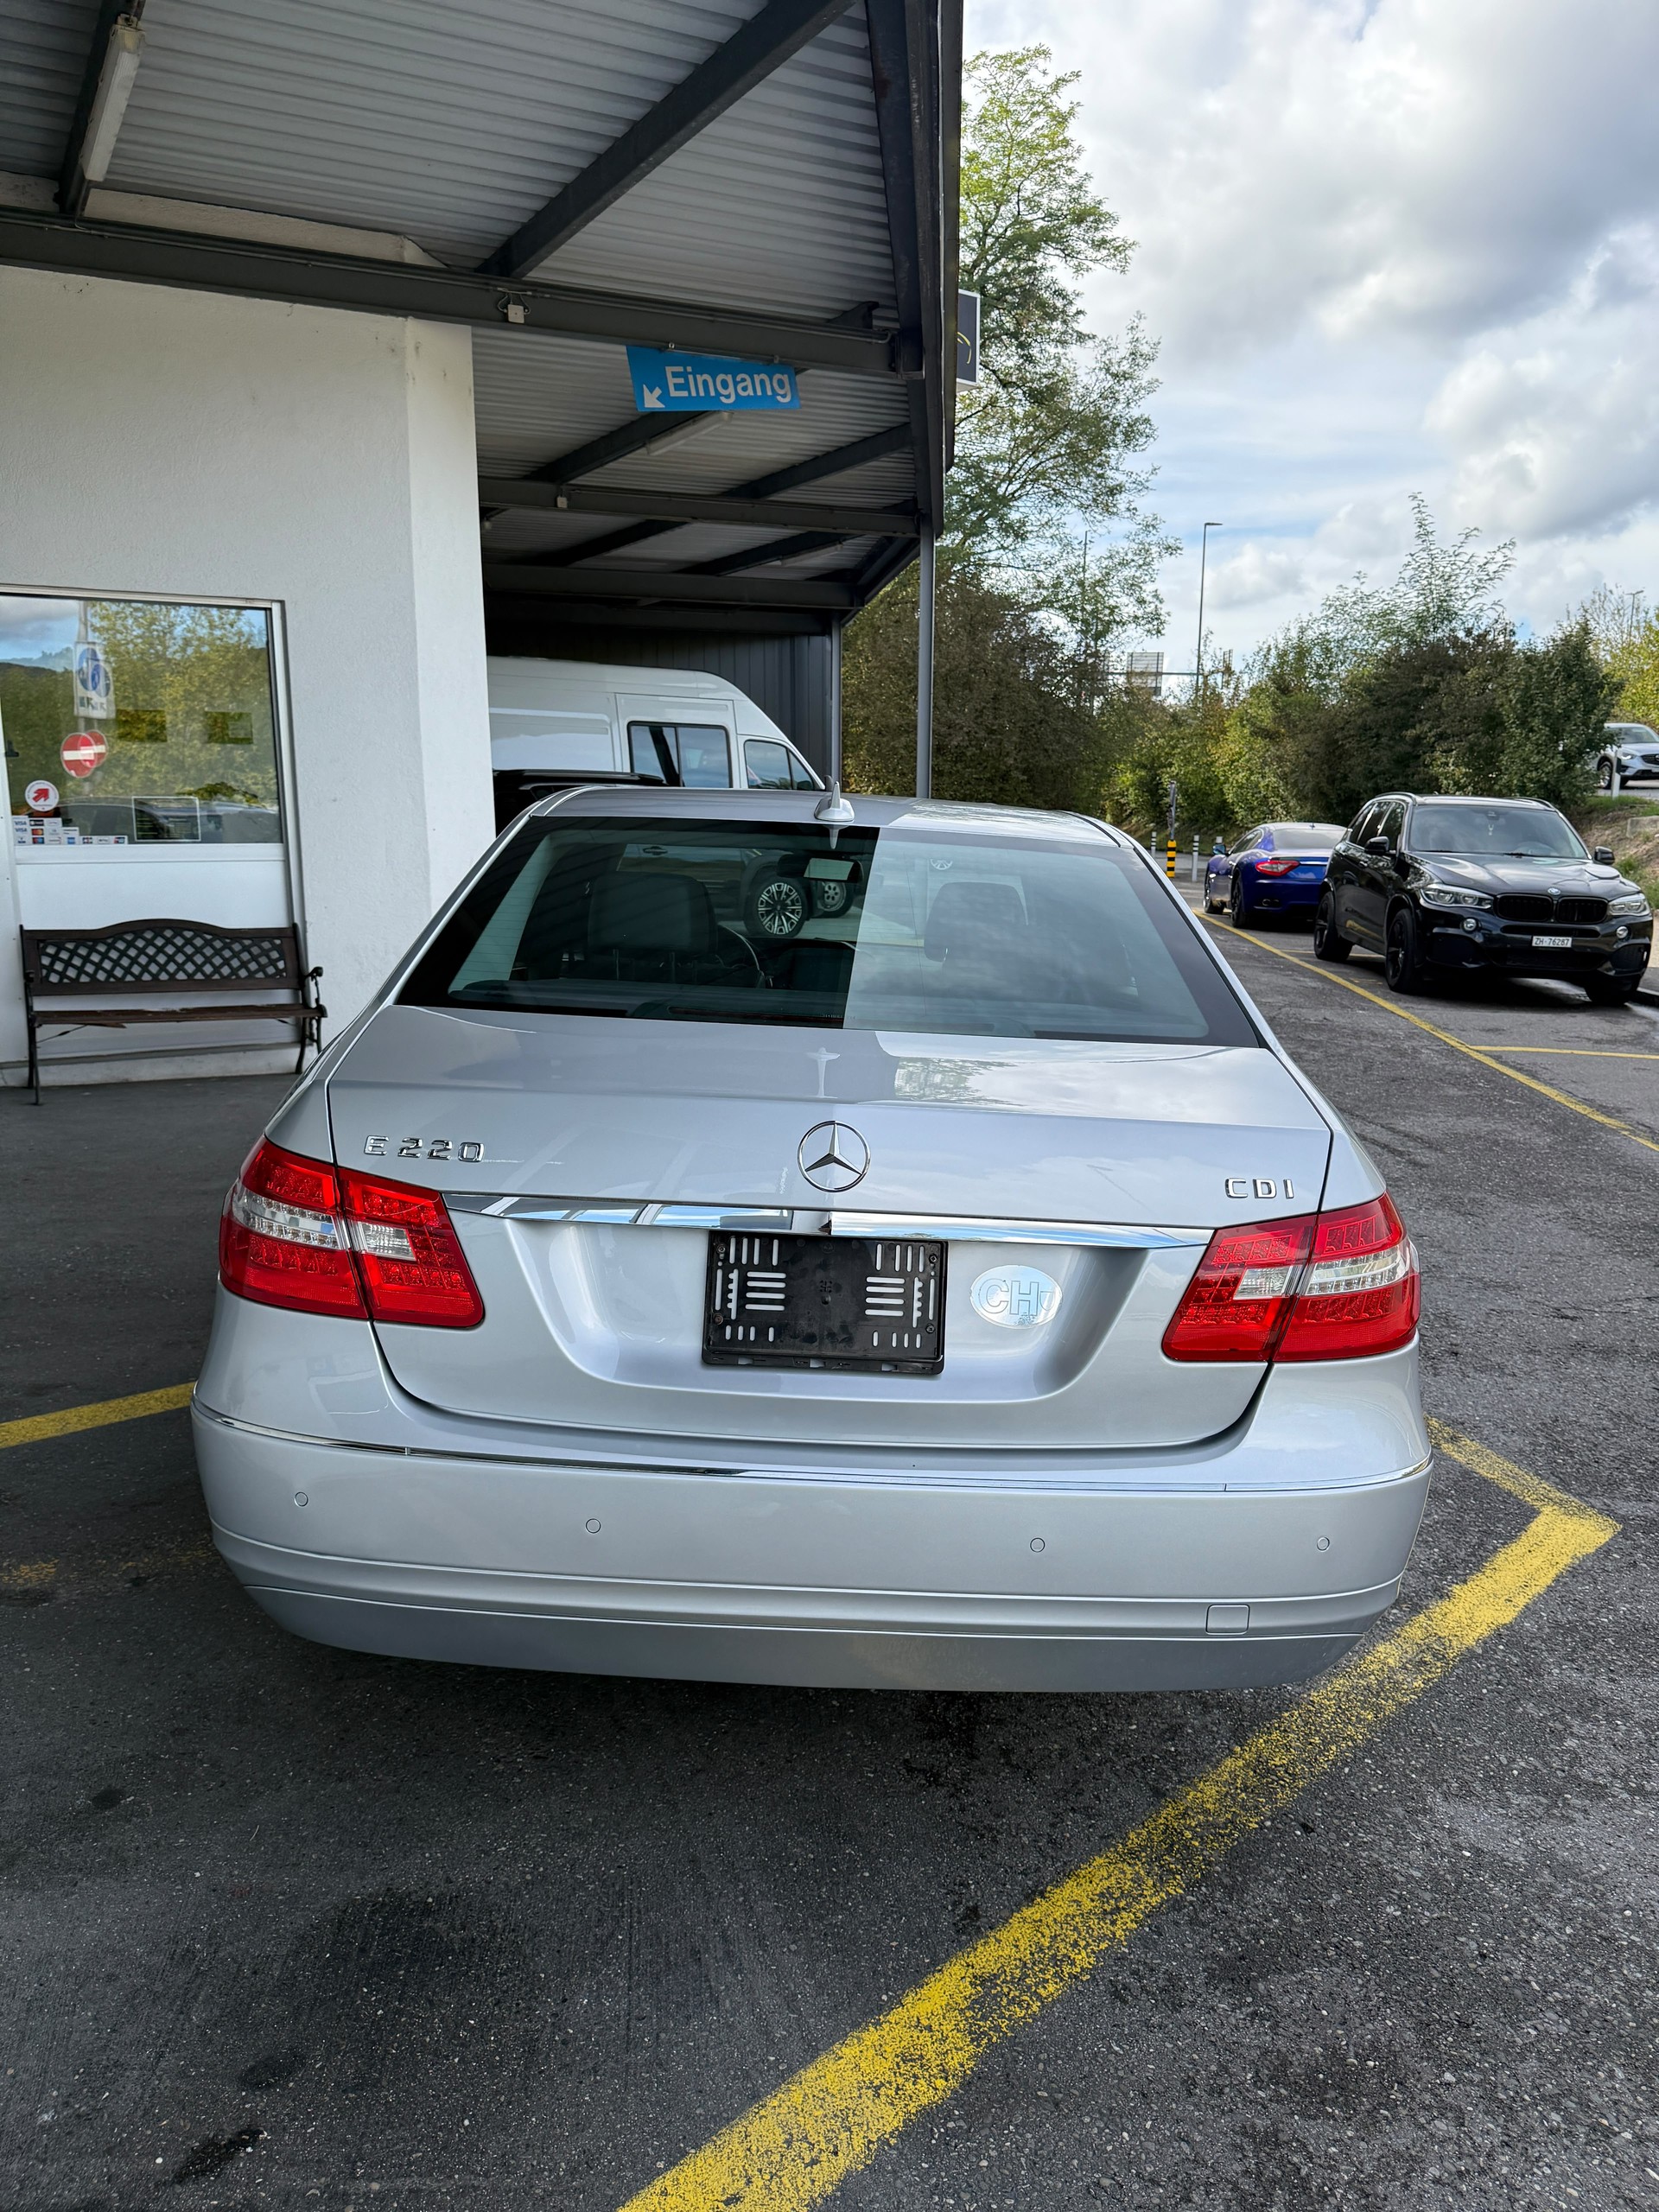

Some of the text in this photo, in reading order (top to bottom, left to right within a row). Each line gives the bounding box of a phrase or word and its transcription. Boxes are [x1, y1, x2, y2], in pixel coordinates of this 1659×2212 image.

[664, 366, 791, 404] Eingang
[364, 1135, 485, 1162] E 220
[1224, 1178, 1294, 1199] CDI
[978, 1278, 1039, 1316] CH
